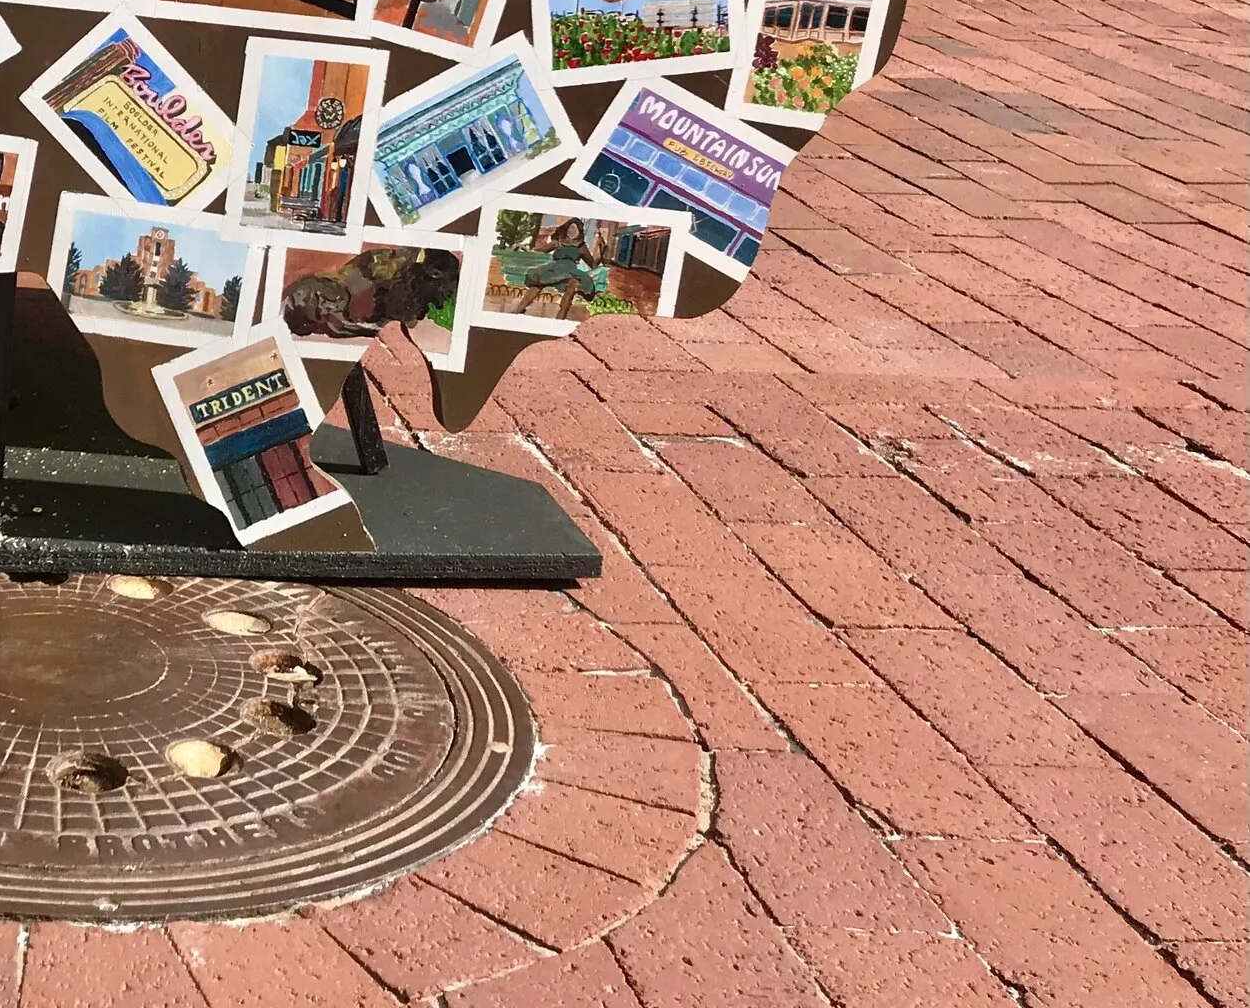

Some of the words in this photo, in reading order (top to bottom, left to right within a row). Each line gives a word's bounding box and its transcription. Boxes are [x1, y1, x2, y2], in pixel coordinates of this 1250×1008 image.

[97, 108, 119, 131] FILM
[125, 138, 165, 180] FESTIVAL
[102, 96, 169, 165] INTERNATIONAL
[120, 62, 218, 164] Boulder
[122, 101, 158, 138] BOULDER
[196, 373, 283, 418] TRIDENT
[56, 803, 330, 860] BROTHERS
